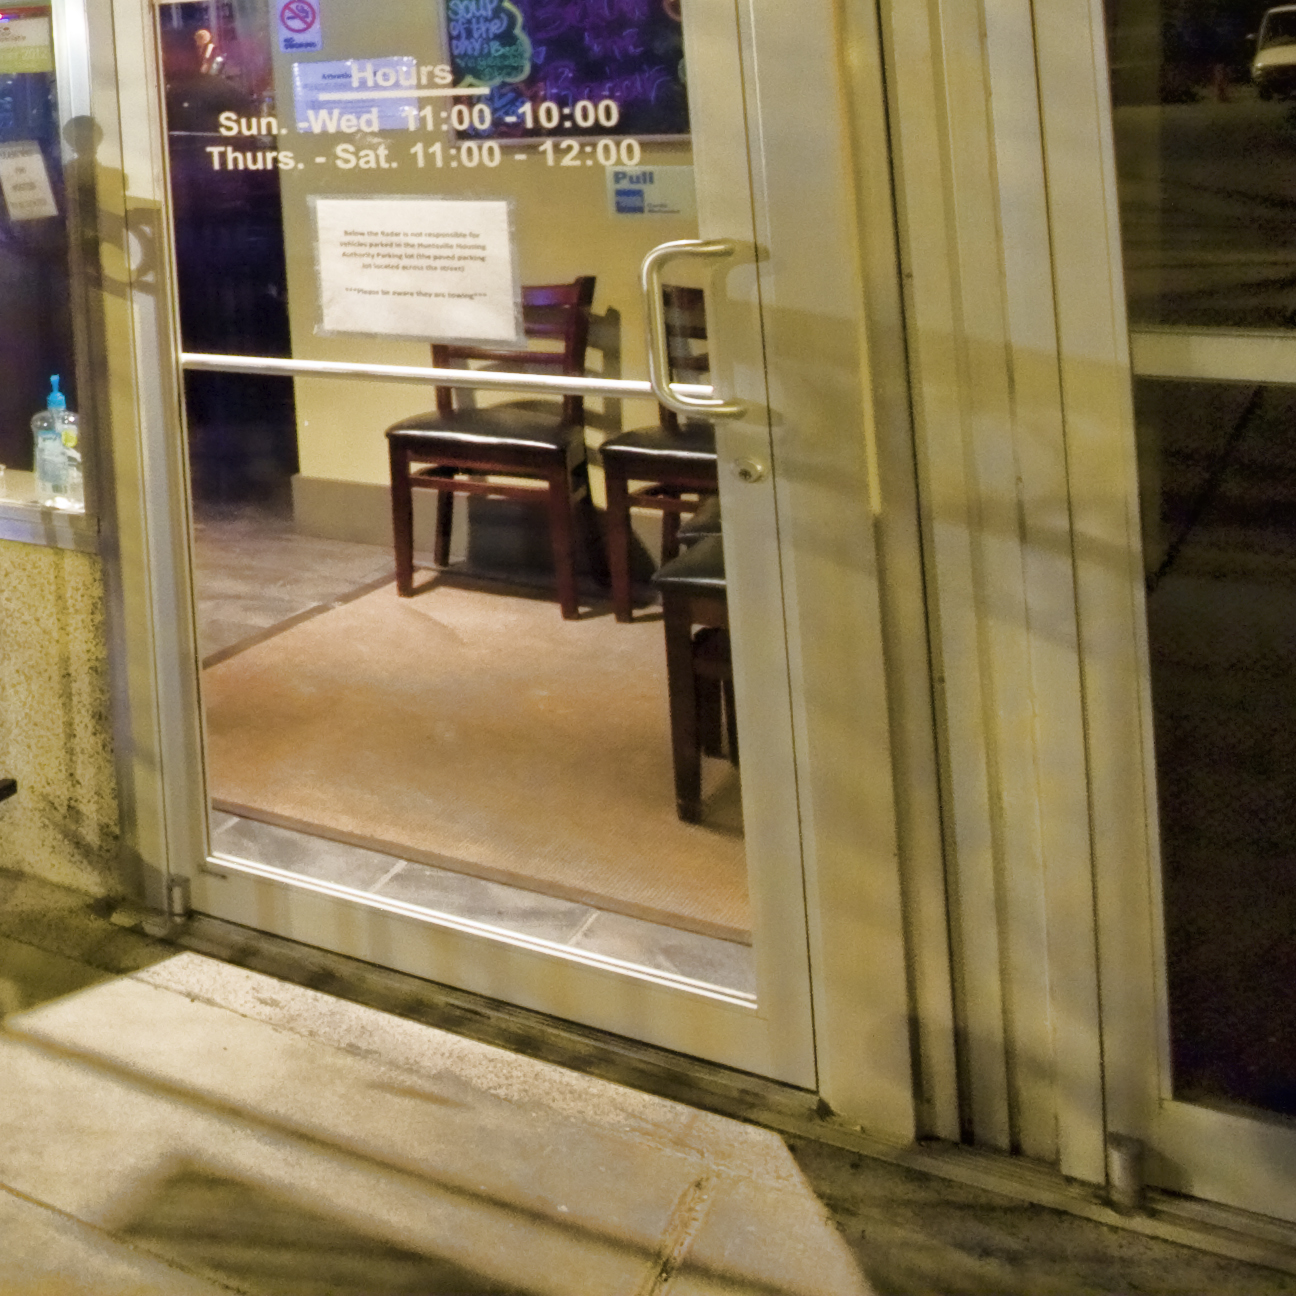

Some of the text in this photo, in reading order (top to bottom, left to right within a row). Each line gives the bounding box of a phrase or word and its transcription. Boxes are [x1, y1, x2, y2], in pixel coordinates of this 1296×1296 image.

[350, 61, 454, 89] Hours
[219, 111, 288, 136] Sun.
[404, 104, 492, 132] 11:00
[206, 146, 305, 171] Thurs.
[335, 143, 398, 170] Sat.
[410, 140, 501, 168] 11:00
[538, 138, 642, 166] 12:00
[613, 171, 654, 184] Pull
